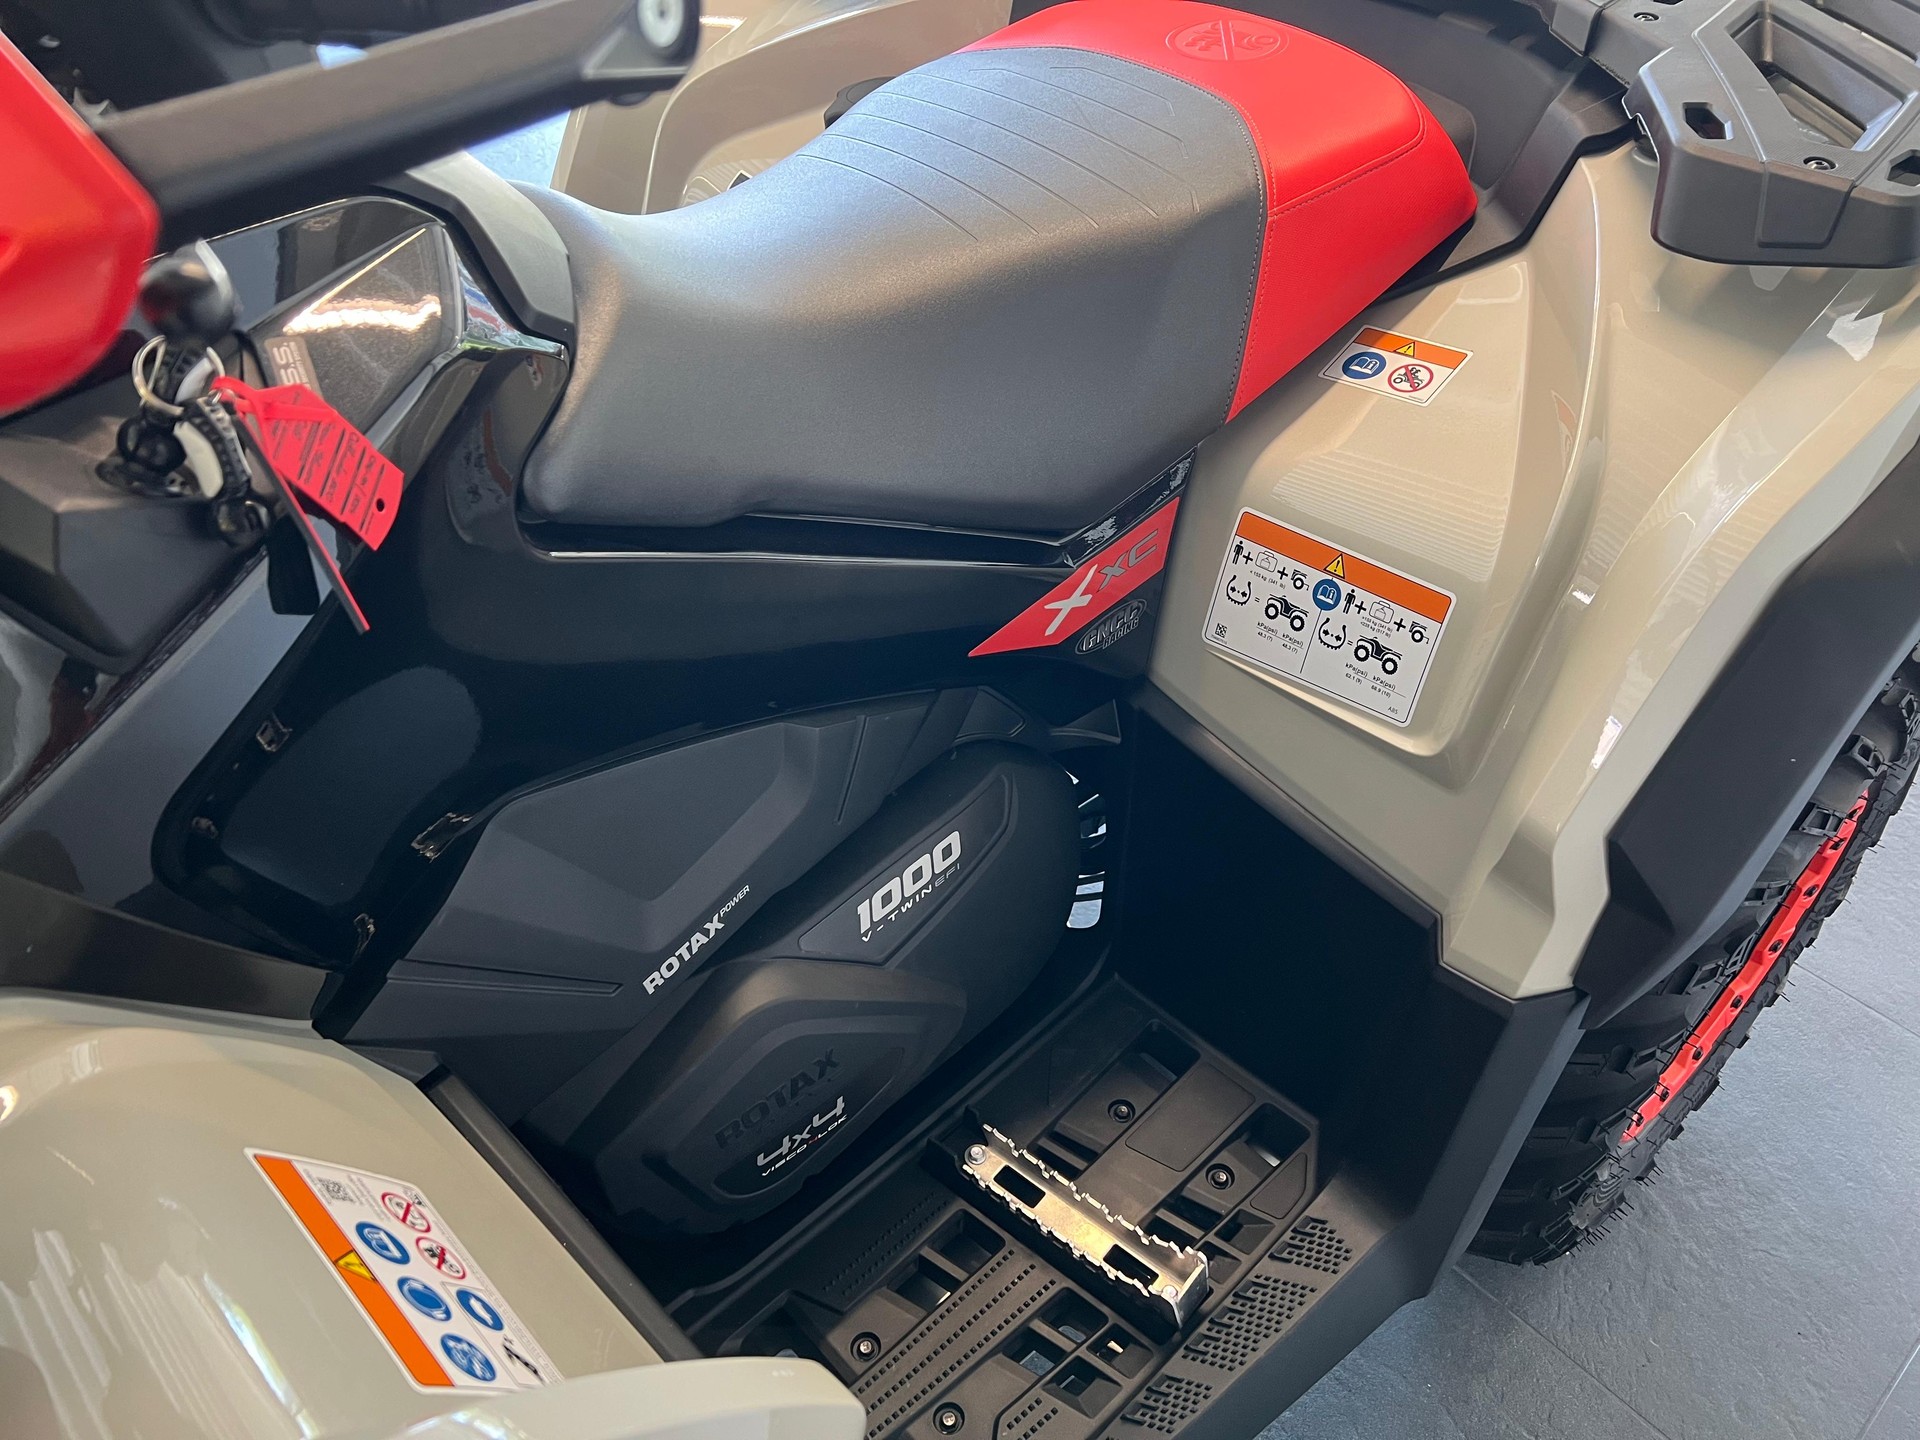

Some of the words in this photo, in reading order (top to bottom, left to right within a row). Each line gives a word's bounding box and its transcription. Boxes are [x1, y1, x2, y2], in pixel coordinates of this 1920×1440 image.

[857, 830, 962, 934] 1000
[642, 912, 725, 995] ROTAX
[719, 884, 750, 918] POWER
[714, 1047, 840, 1150] ROTAX
